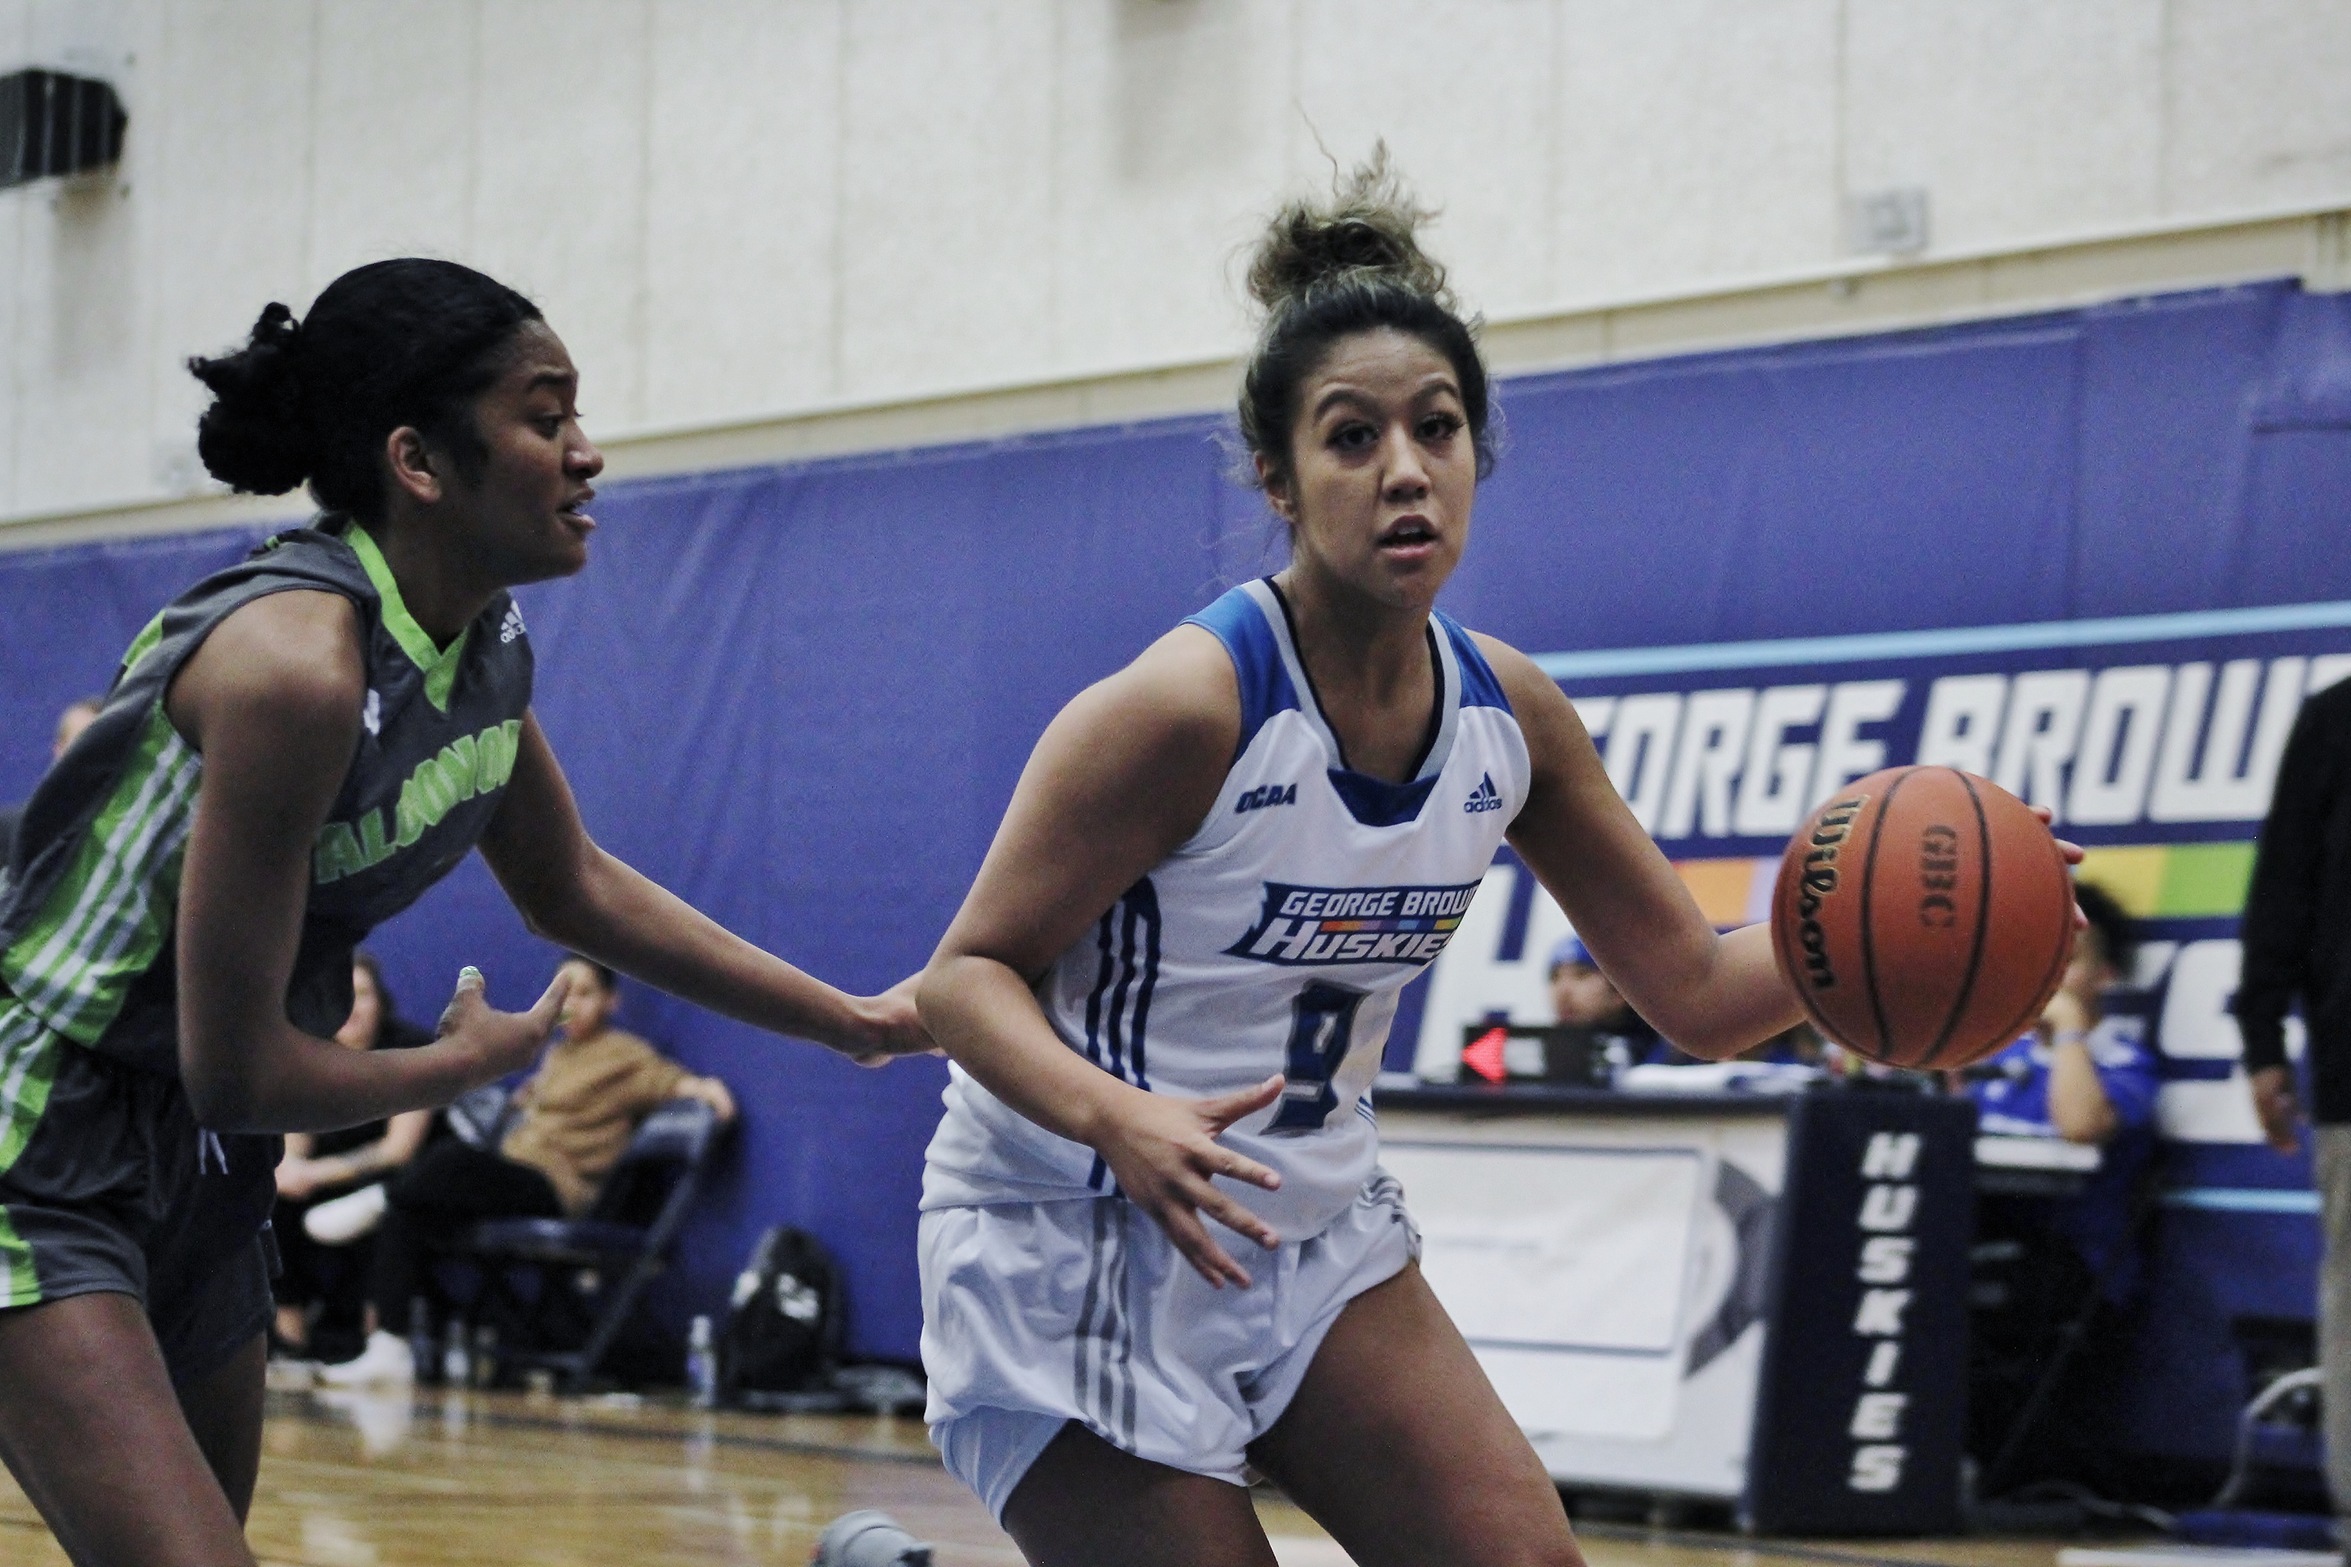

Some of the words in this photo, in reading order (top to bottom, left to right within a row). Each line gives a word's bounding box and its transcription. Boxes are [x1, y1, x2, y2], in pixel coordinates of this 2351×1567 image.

[1463, 798, 1502, 813] adidas
[1570, 678, 1906, 839] ORGE
[1915, 652, 2351, 827] BROW
[1279, 891, 1401, 917] GEORGE
[1800, 794, 1871, 990] Wilson
[1920, 824, 1958, 928] GBC
[1259, 977, 1374, 1137] 9
[1848, 1130, 1923, 1493] HUSKIES
